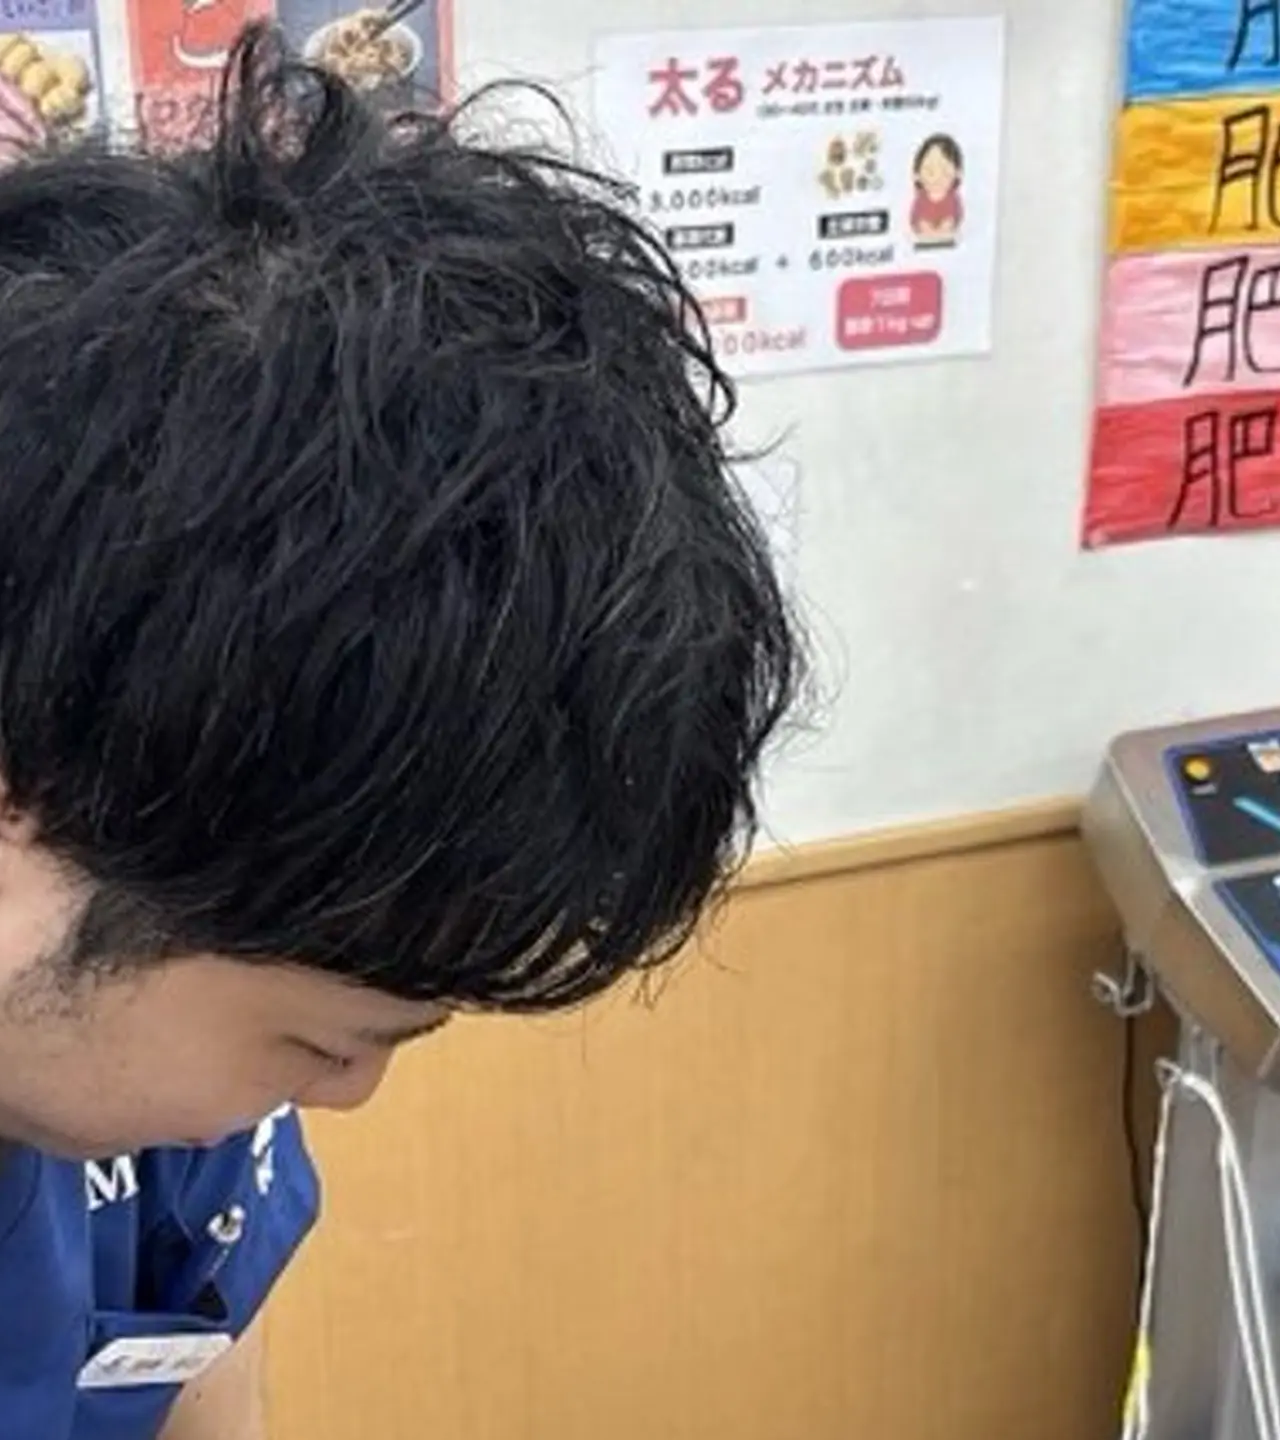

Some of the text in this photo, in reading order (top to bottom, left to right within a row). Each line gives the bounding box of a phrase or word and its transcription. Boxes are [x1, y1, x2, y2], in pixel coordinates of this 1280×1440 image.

[647, 57, 745, 118] 太る
[761, 55, 905, 94] メカニズム
